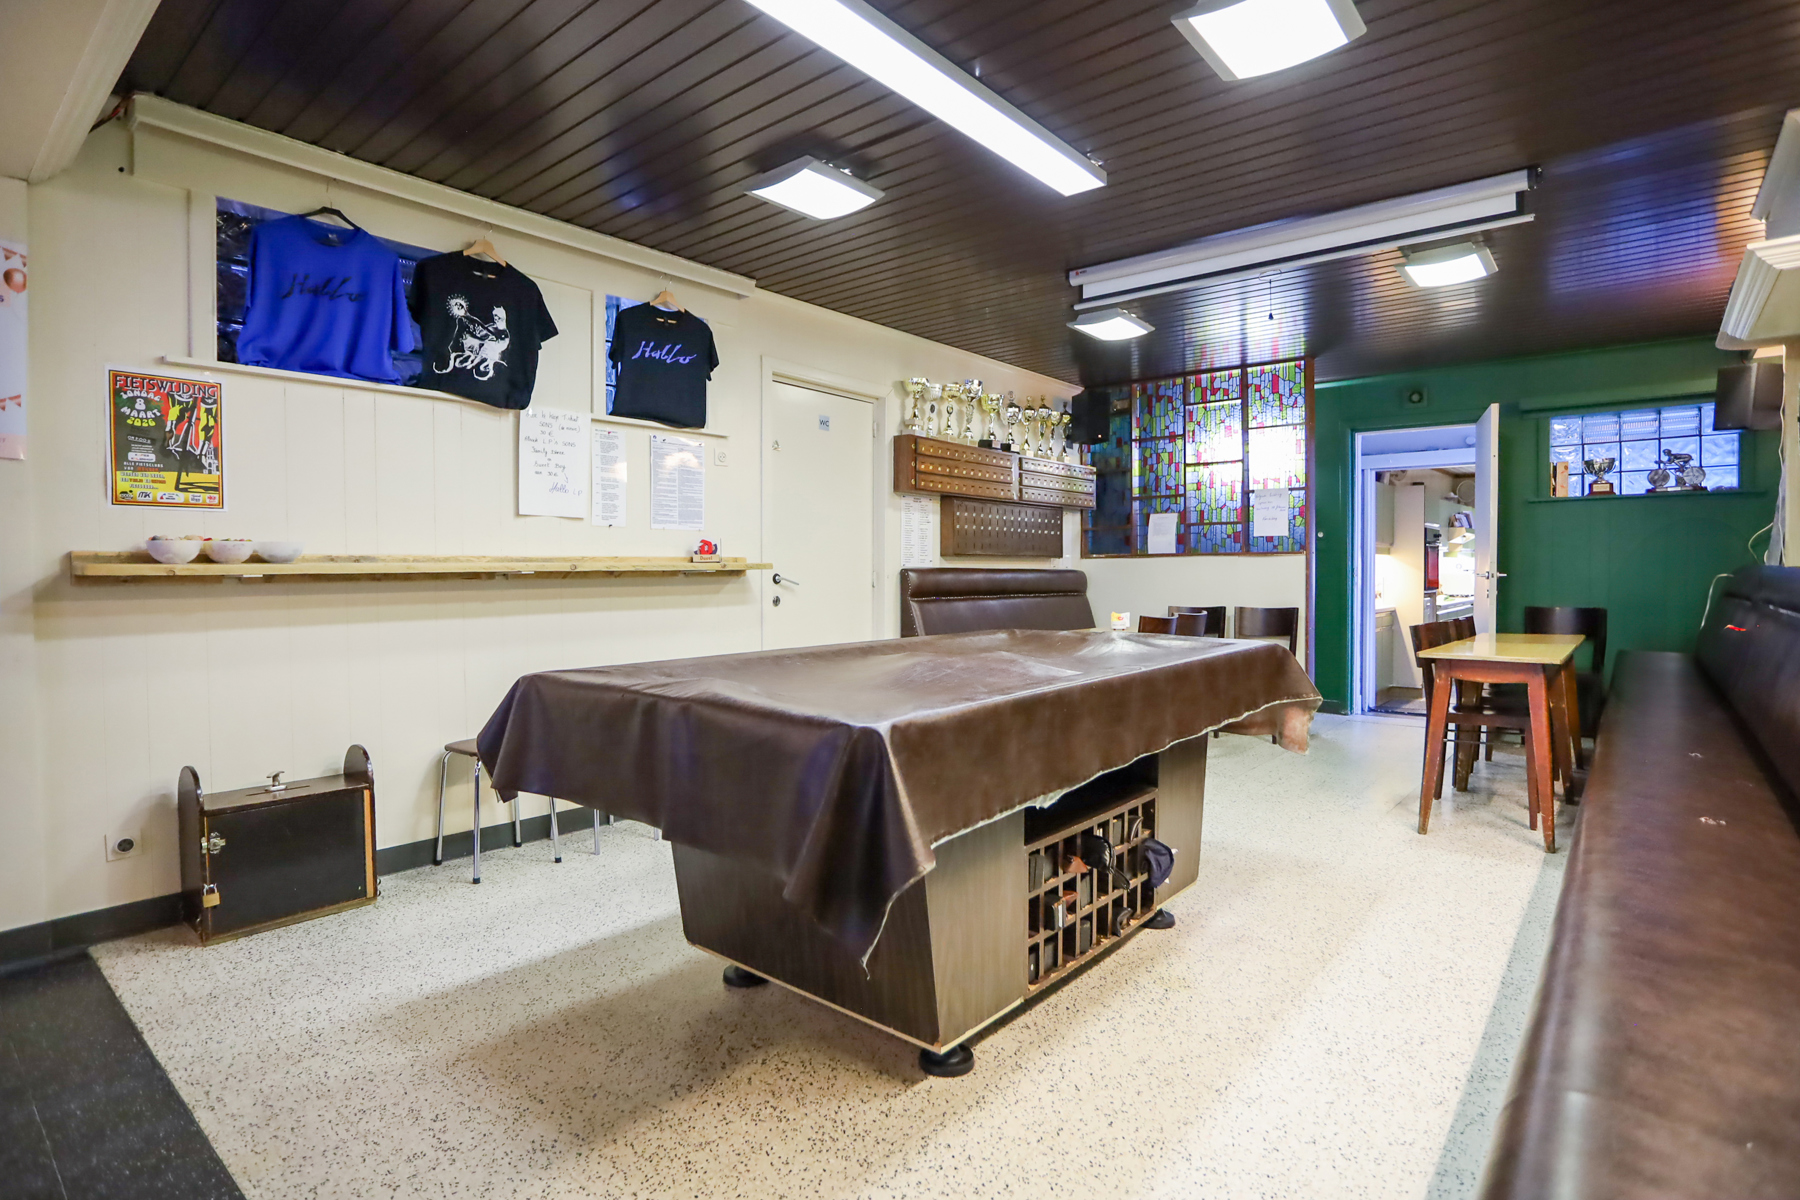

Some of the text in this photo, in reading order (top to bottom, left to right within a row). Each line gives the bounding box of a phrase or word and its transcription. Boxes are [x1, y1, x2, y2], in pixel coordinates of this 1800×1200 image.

[631, 340, 698, 365] Hallo
[115, 375, 217, 398] FIETSWIJDING
[120, 390, 162, 402] ZONDAG
[134, 398, 146, 411] 8
[120, 406, 161, 419] MAART
[126, 416, 156, 427] 2026
[819, 418, 830, 428] WC
